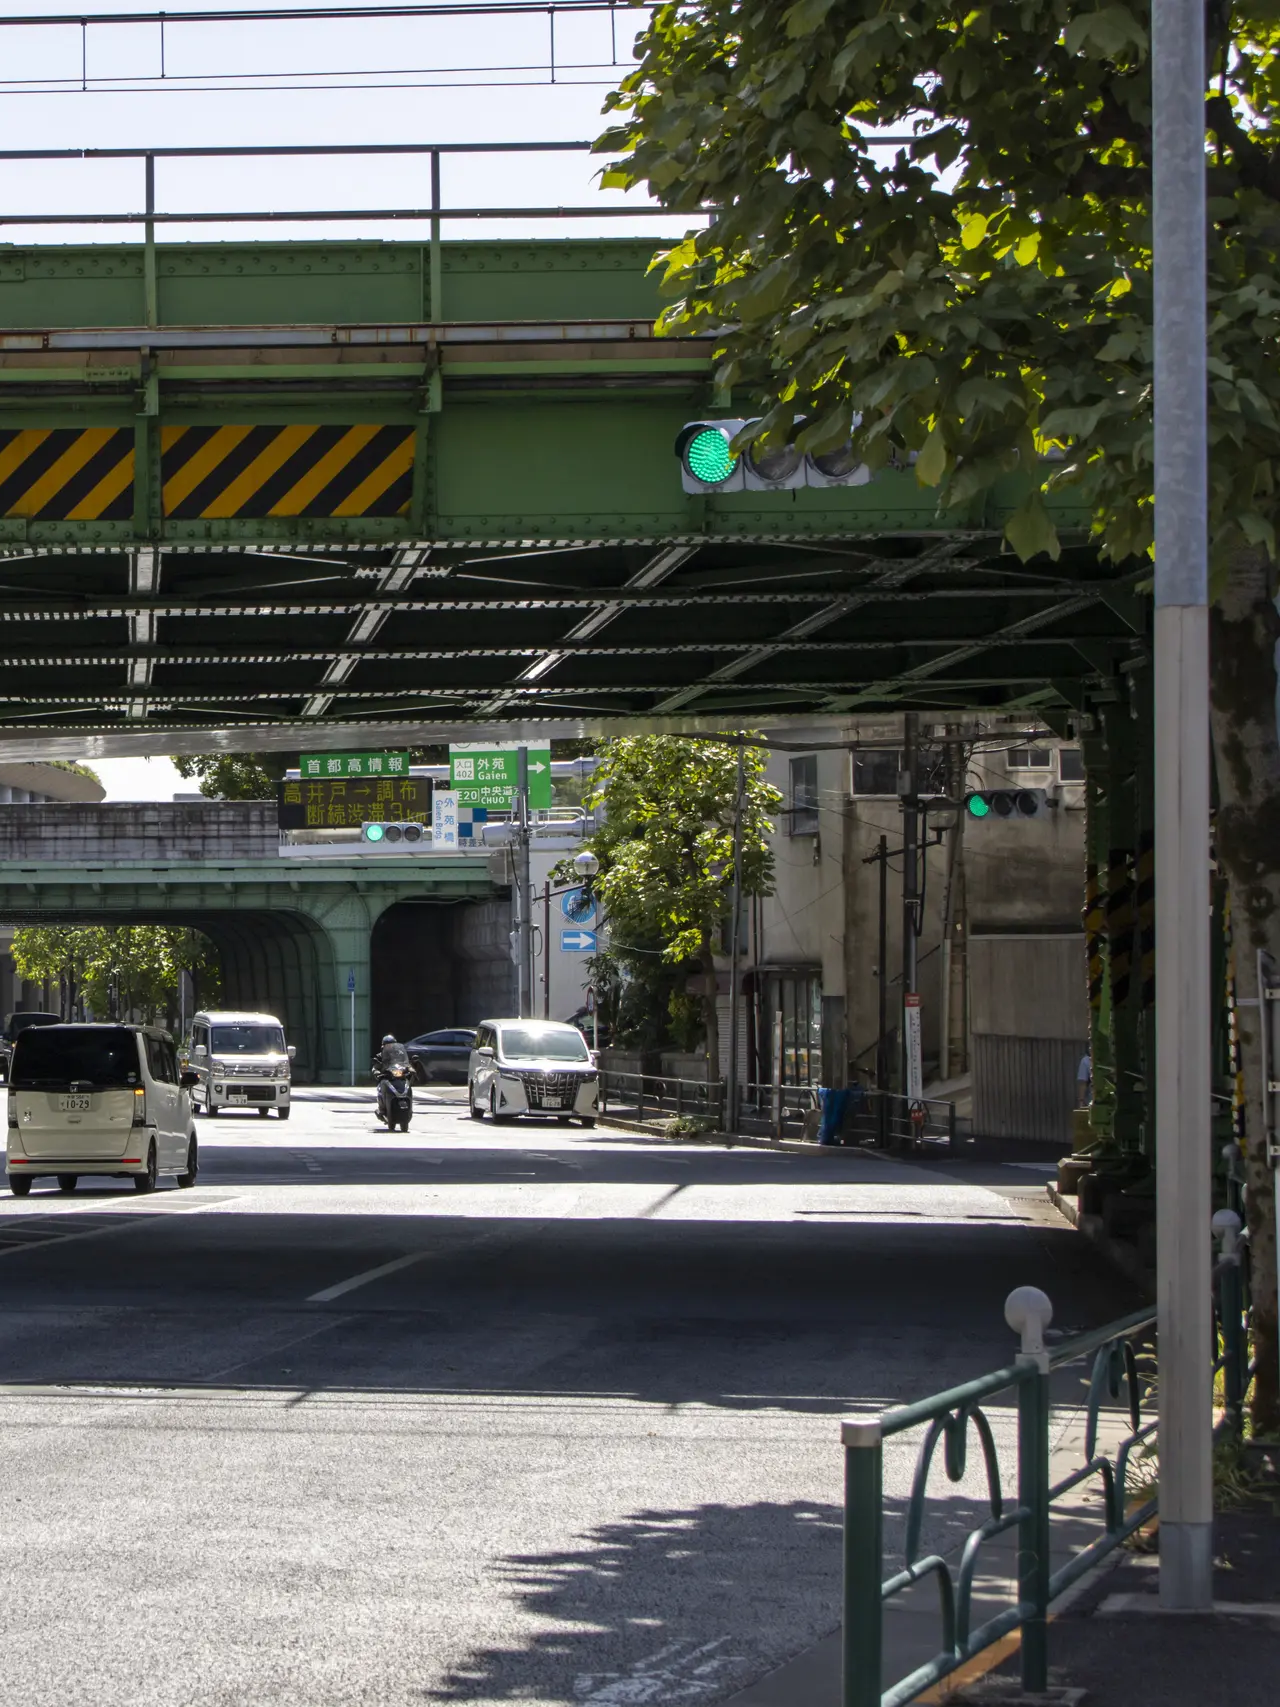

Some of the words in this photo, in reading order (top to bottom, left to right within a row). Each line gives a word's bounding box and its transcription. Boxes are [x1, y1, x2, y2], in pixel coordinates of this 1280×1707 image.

[307, 757, 403, 774] 首都高情報
[456, 760, 472, 769] 入口
[477, 758, 505, 770] 外苑
[456, 770, 472, 779] 402
[478, 771, 507, 780] Gaien
[481, 796, 505, 804] CHUO
[435, 800, 443, 821] Gaien
[444, 797, 455, 843] 外苑橋
[66, 1099, 90, 1109] 10-29
